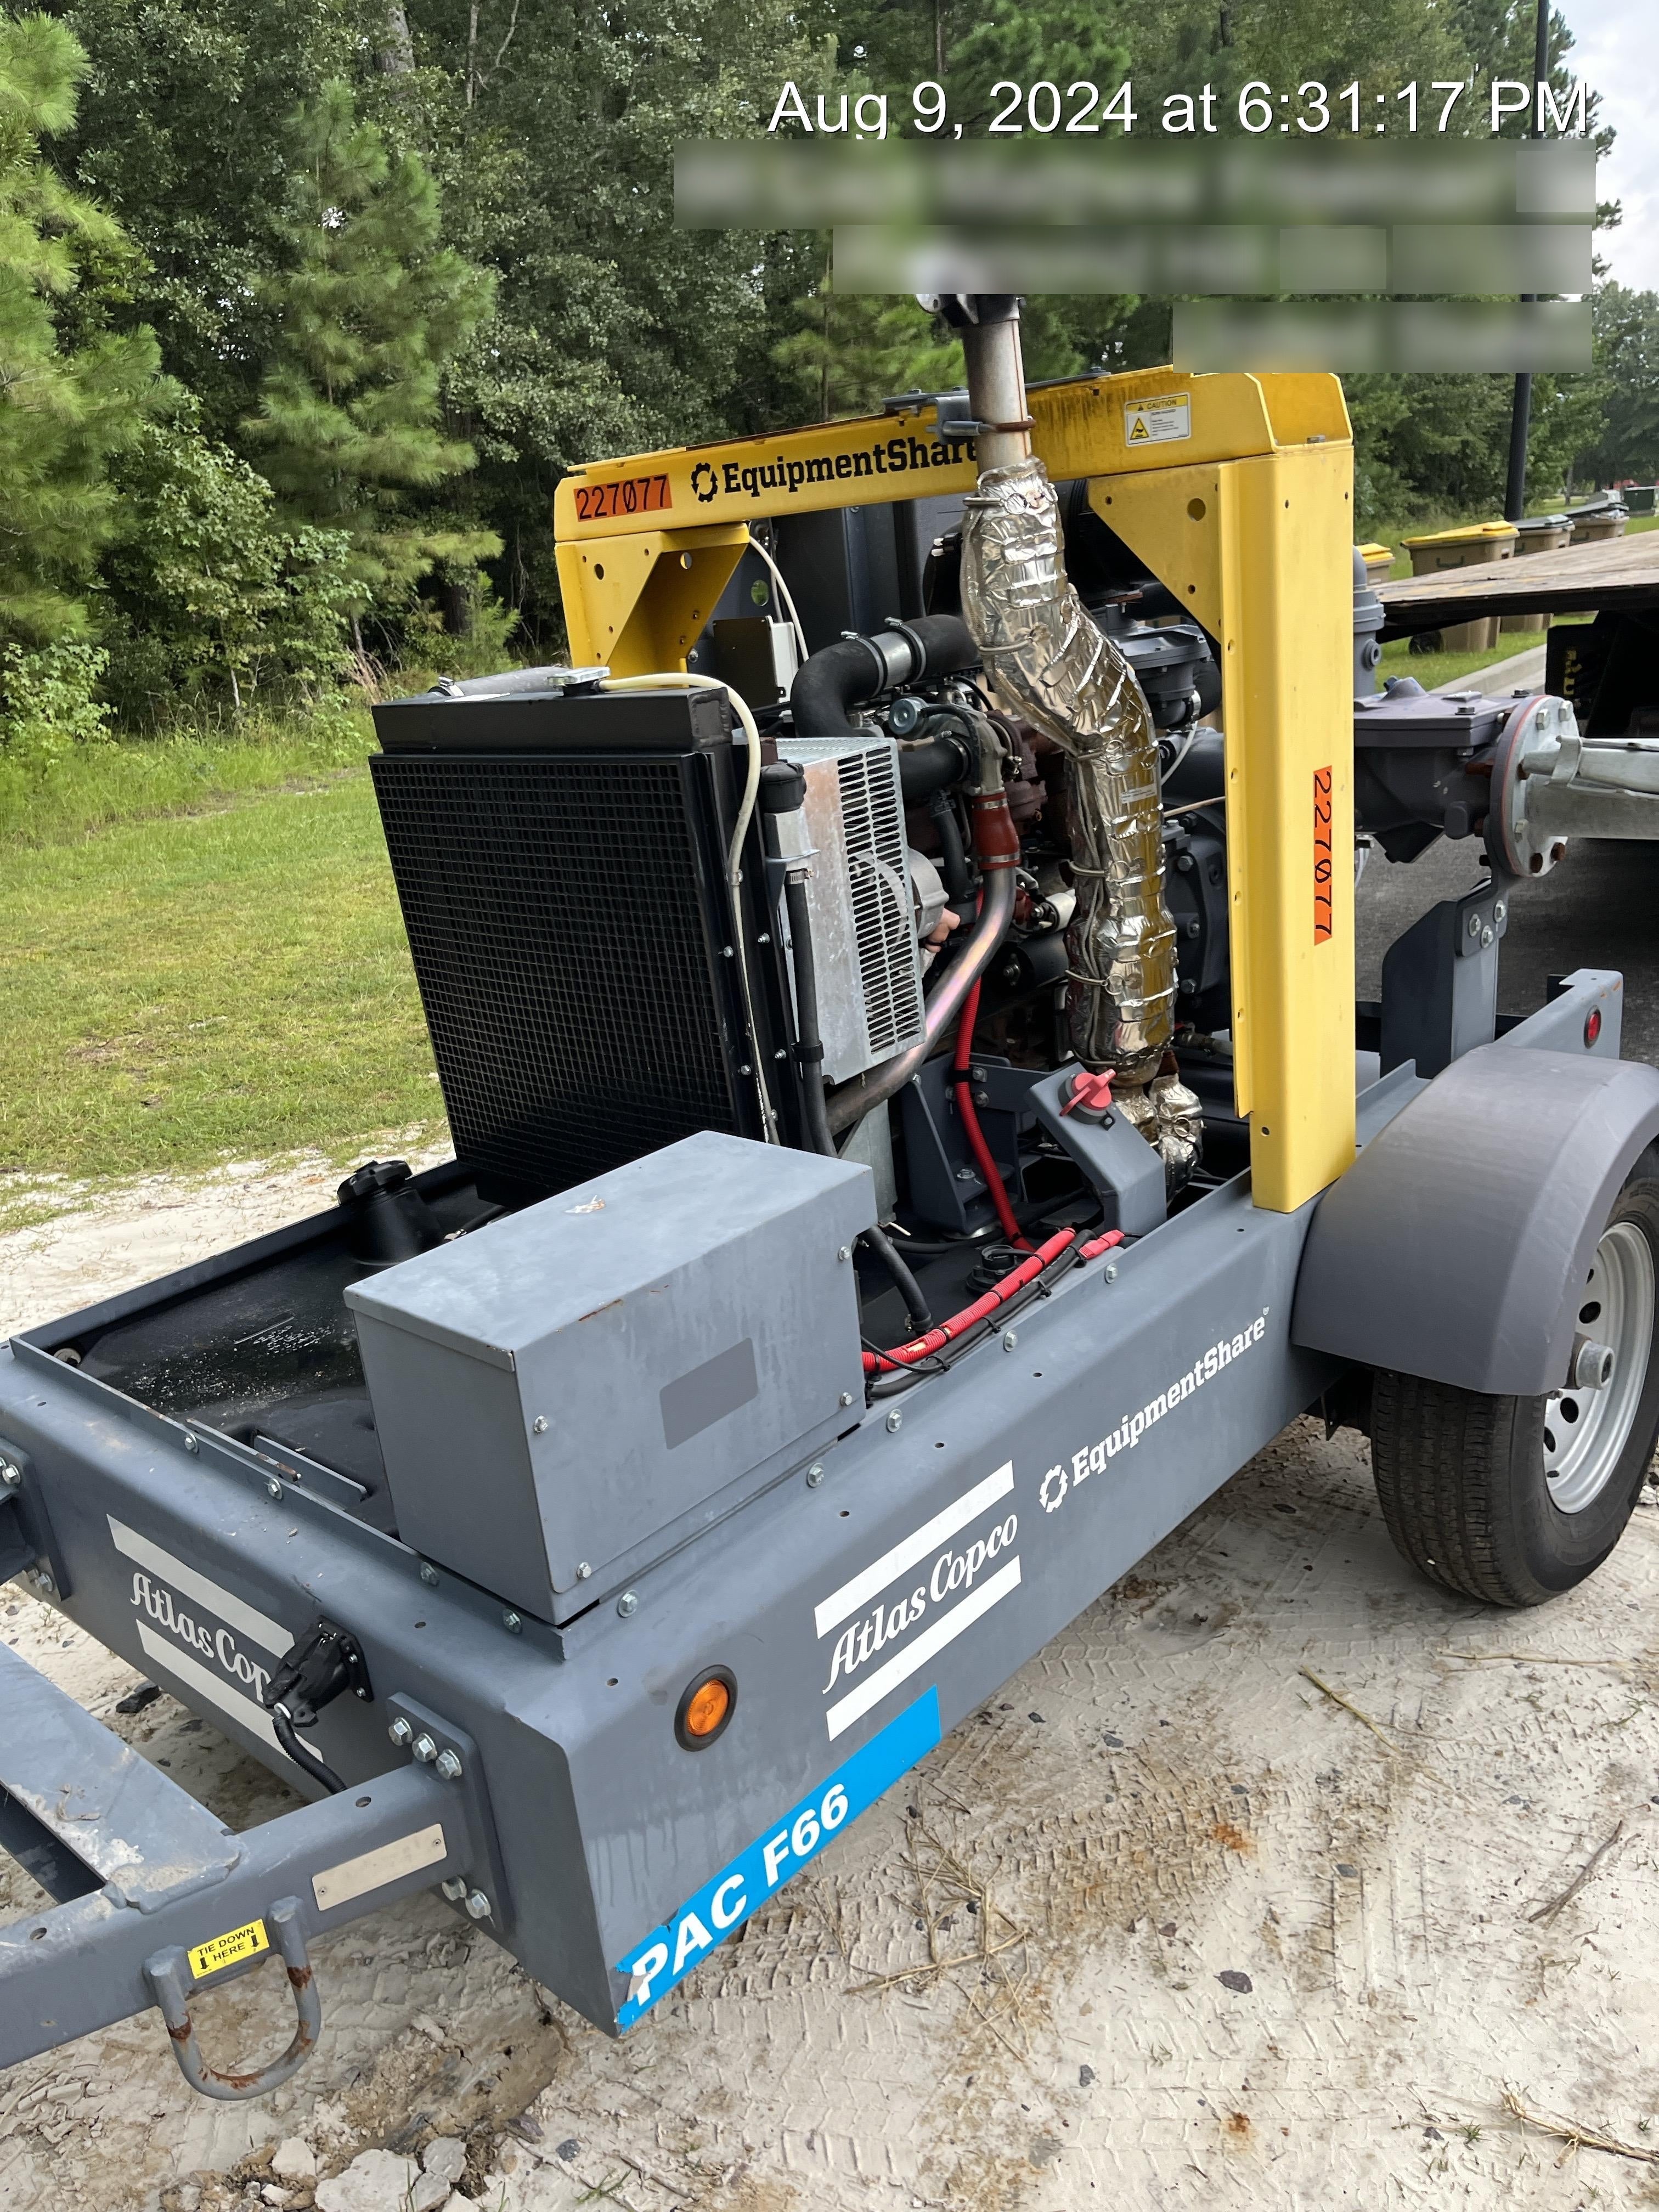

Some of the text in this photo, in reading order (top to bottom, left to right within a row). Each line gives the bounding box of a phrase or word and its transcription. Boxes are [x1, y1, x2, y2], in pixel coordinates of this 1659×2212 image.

[1147, 399, 1176, 409] CAUTION
[577, 476, 668, 521] 227077
[1314, 771, 1332, 935] 227077
[130, 1572, 272, 1703] Atlas Cop
[822, 1514, 1018, 1695] Atlas Copco
[631, 1784, 849, 2006] PAC F66
[197, 1927, 255, 1956] TIE DOWN
[213, 1942, 246, 1961] HERE
